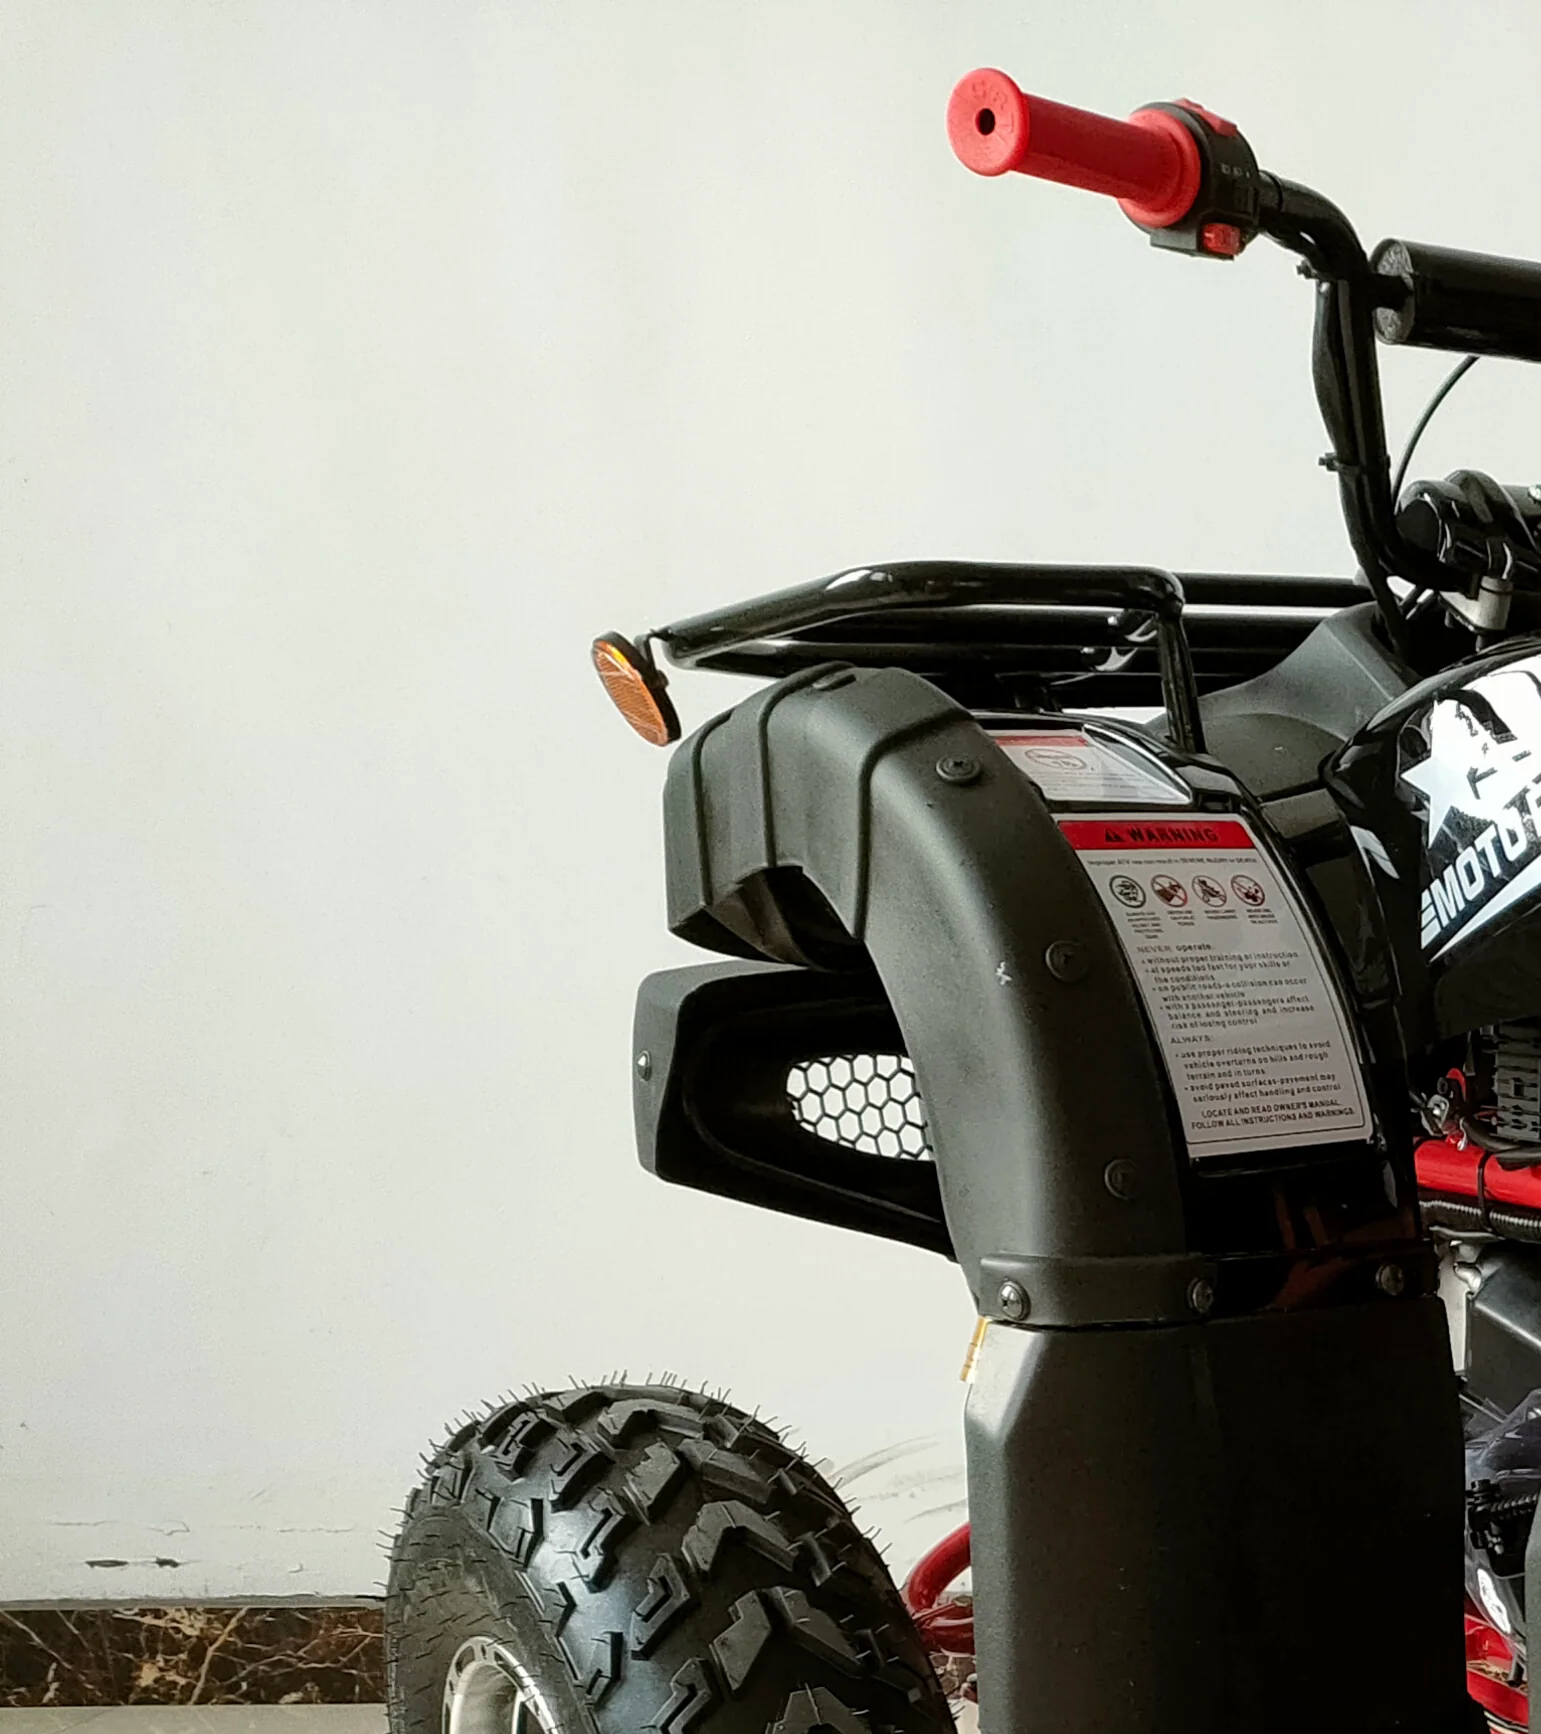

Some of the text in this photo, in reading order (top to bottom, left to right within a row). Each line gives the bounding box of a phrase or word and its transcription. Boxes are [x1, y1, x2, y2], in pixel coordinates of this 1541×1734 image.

[1127, 827, 1219, 842] WARNING
[1136, 945, 1171, 953] NEVER
[1181, 955, 1208, 963] proper
[1160, 965, 1191, 974] speeds
[1197, 1049, 1225, 1057] proper
[1226, 1046, 1252, 1055] riding
[1184, 1061, 1214, 1069] vehicle
[1218, 1069, 1232, 1078] and
[1215, 1080, 1240, 1090] paved
[1259, 1087, 1295, 1097] handling
[1297, 1085, 1310, 1094] and
[1201, 1107, 1232, 1119] LOCATE
[1234, 1106, 1250, 1115] AND
[1251, 1104, 1272, 1114] READ
[1192, 1120, 1224, 1130] FOLLOW
[1226, 1118, 1241, 1126] ALL
[1241, 1113, 1297, 1125] INSTRUCTIONS
[1298, 1111, 1313, 1119] AND
